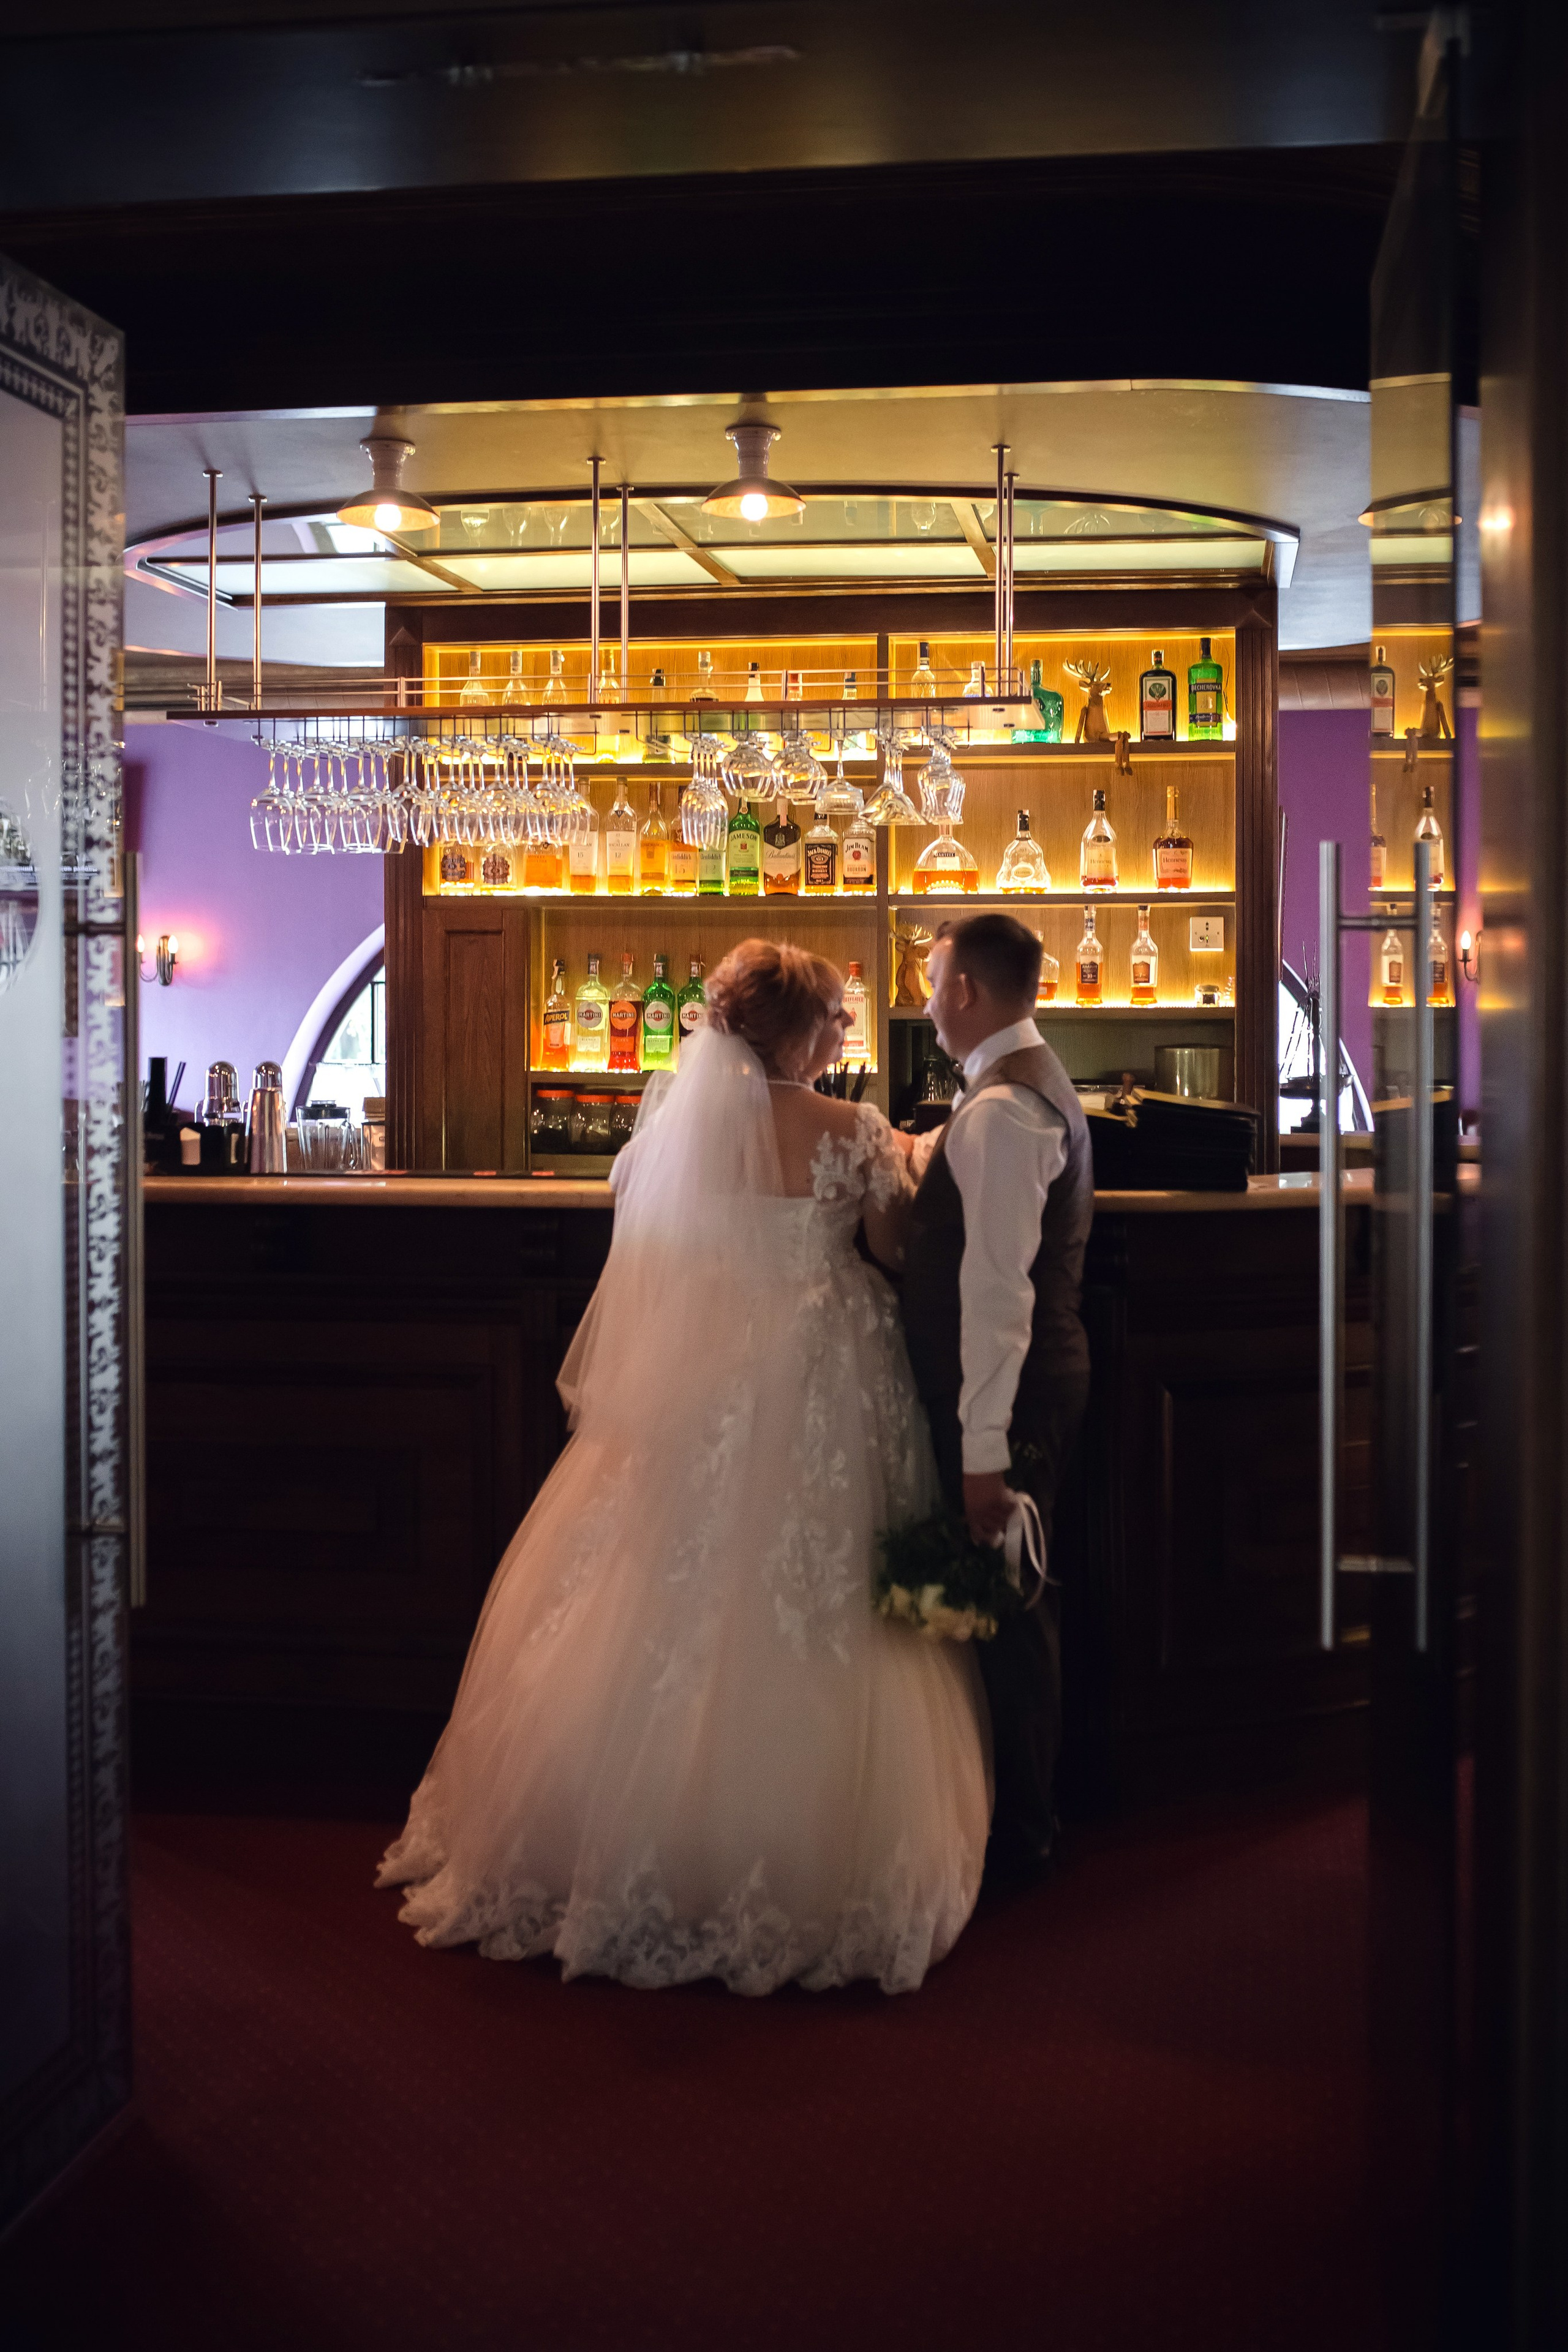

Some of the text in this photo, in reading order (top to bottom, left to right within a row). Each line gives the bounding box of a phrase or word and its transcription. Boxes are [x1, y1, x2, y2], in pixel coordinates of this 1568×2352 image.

[729, 833, 758, 842] JAMESON
[845, 842, 869, 853] JIM BEAM
[545, 1012, 568, 1023] APEROL
